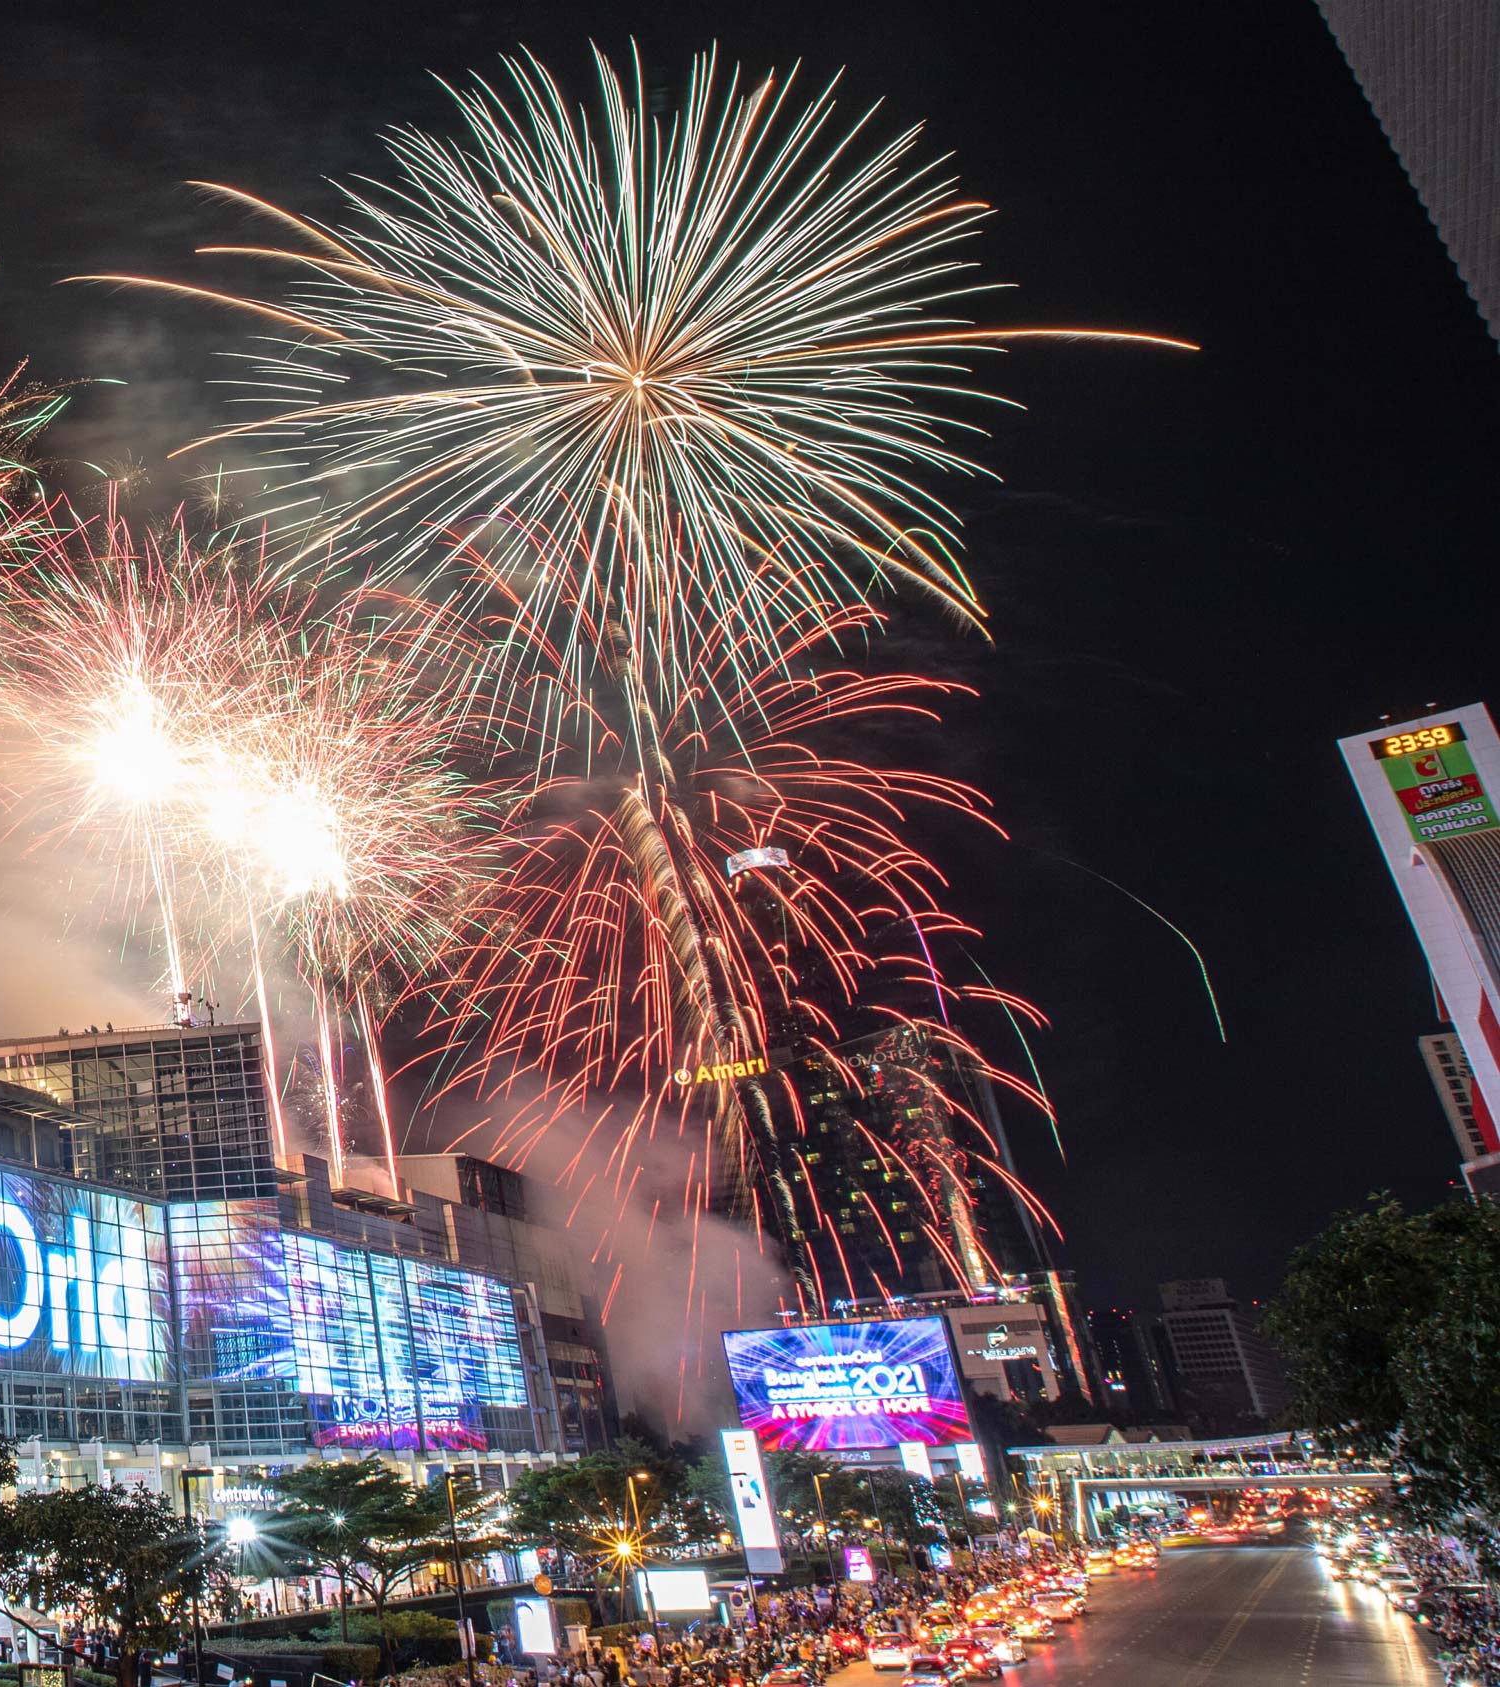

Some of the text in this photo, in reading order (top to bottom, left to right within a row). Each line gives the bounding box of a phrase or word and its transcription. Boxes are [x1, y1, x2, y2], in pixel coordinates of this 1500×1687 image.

[1385, 727, 1450, 756] 23:59
[1414, 801, 1484, 824] ลดทุกวัน
[1419, 814, 1488, 838] ทุกแผนก
[696, 1057, 767, 1084] Amari
[764, 1364, 927, 1396] Bangkok 2021
[772, 1397, 931, 1419] A SYMBOL OF HOPE
